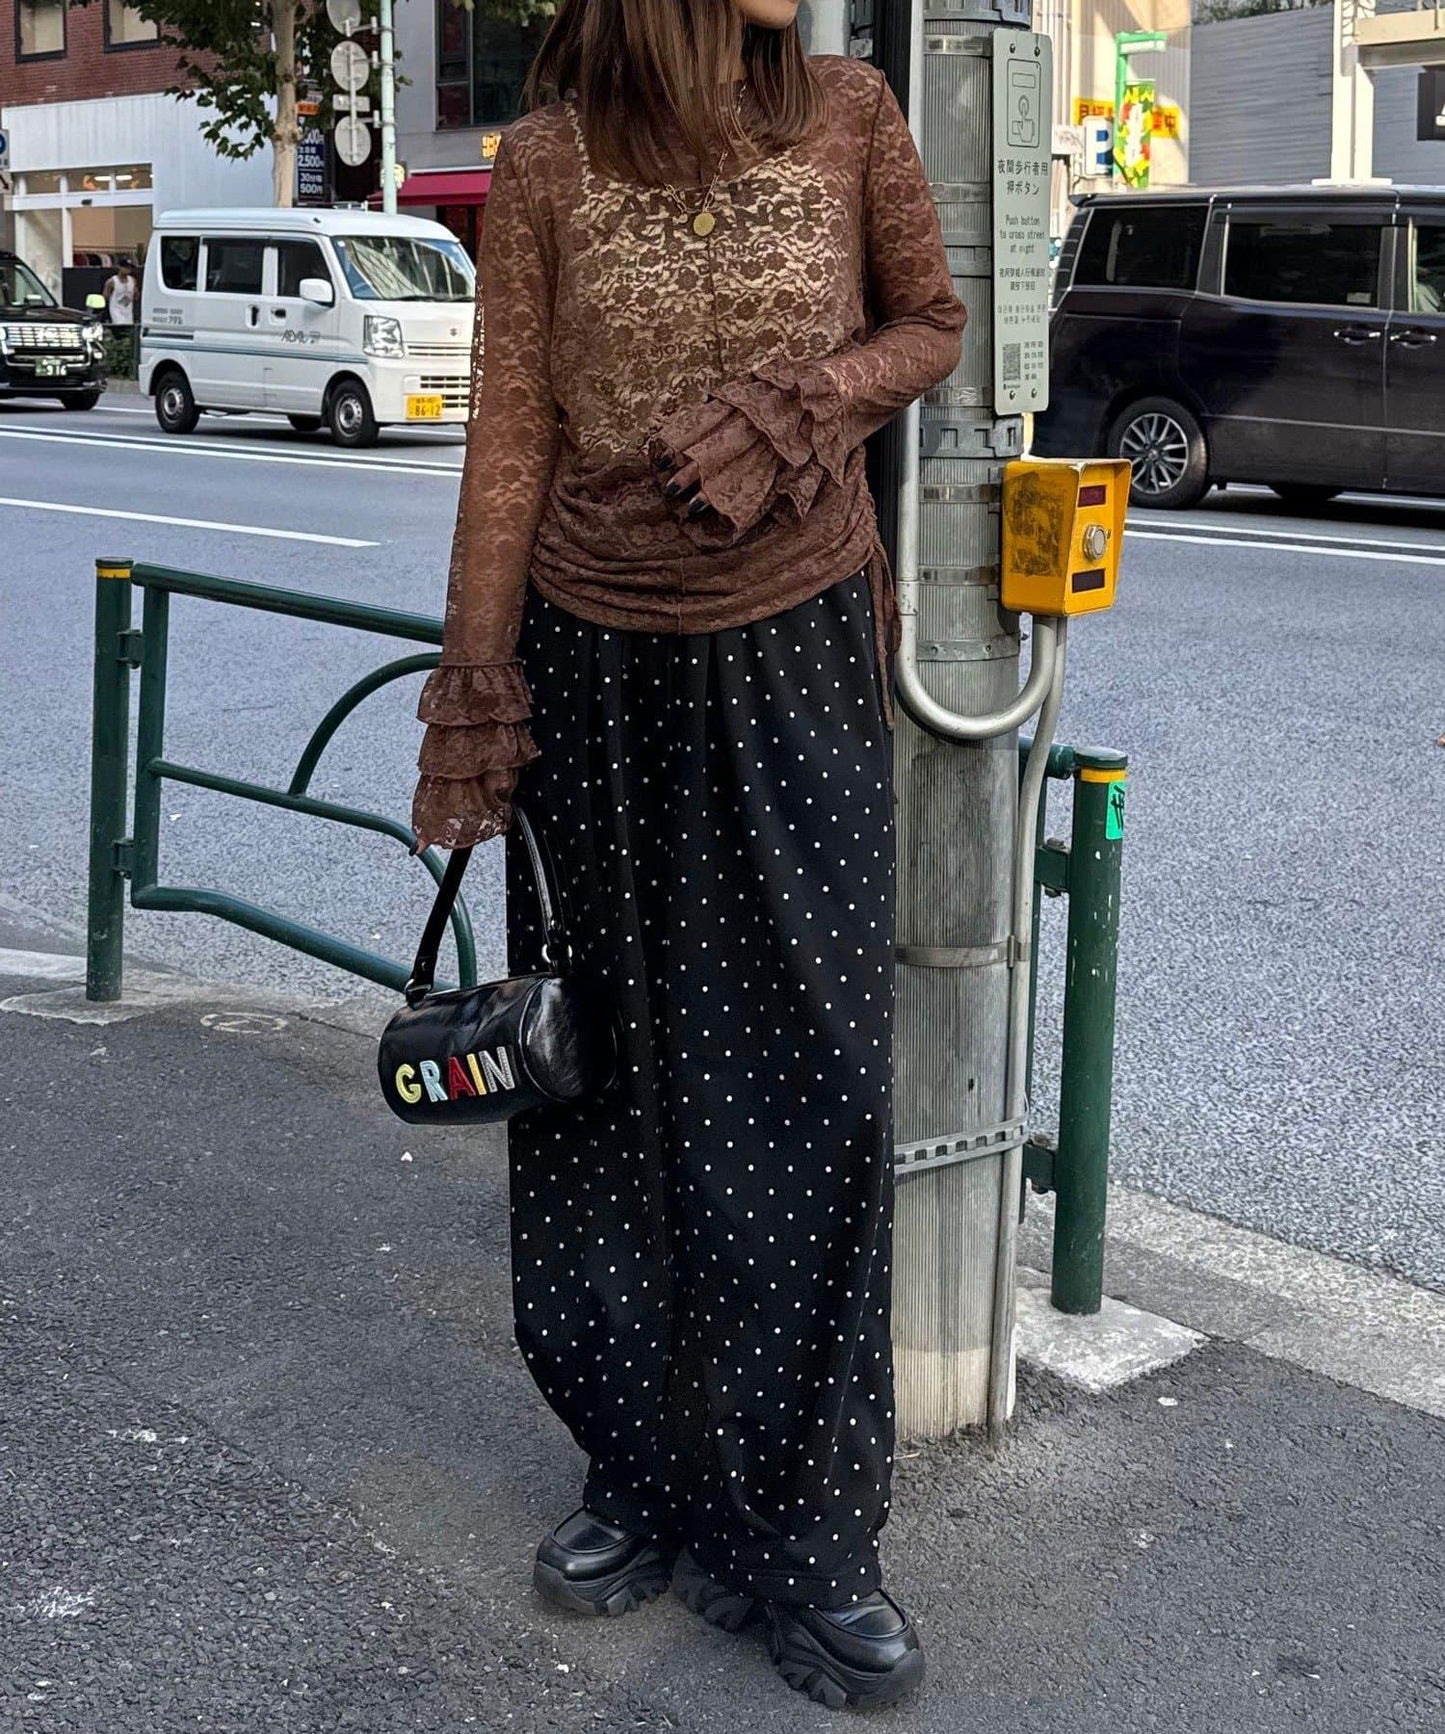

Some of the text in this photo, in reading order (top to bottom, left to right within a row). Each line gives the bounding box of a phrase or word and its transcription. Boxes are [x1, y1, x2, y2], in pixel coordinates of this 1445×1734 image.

[997, 159, 1049, 177] 夜間歩行者用
[1006, 180, 1040, 196] 押ボタン
[1005, 214, 1041, 226] Push button
[1000, 230, 1045, 240] to cross street
[395, 1046, 516, 1104] GRAIN
